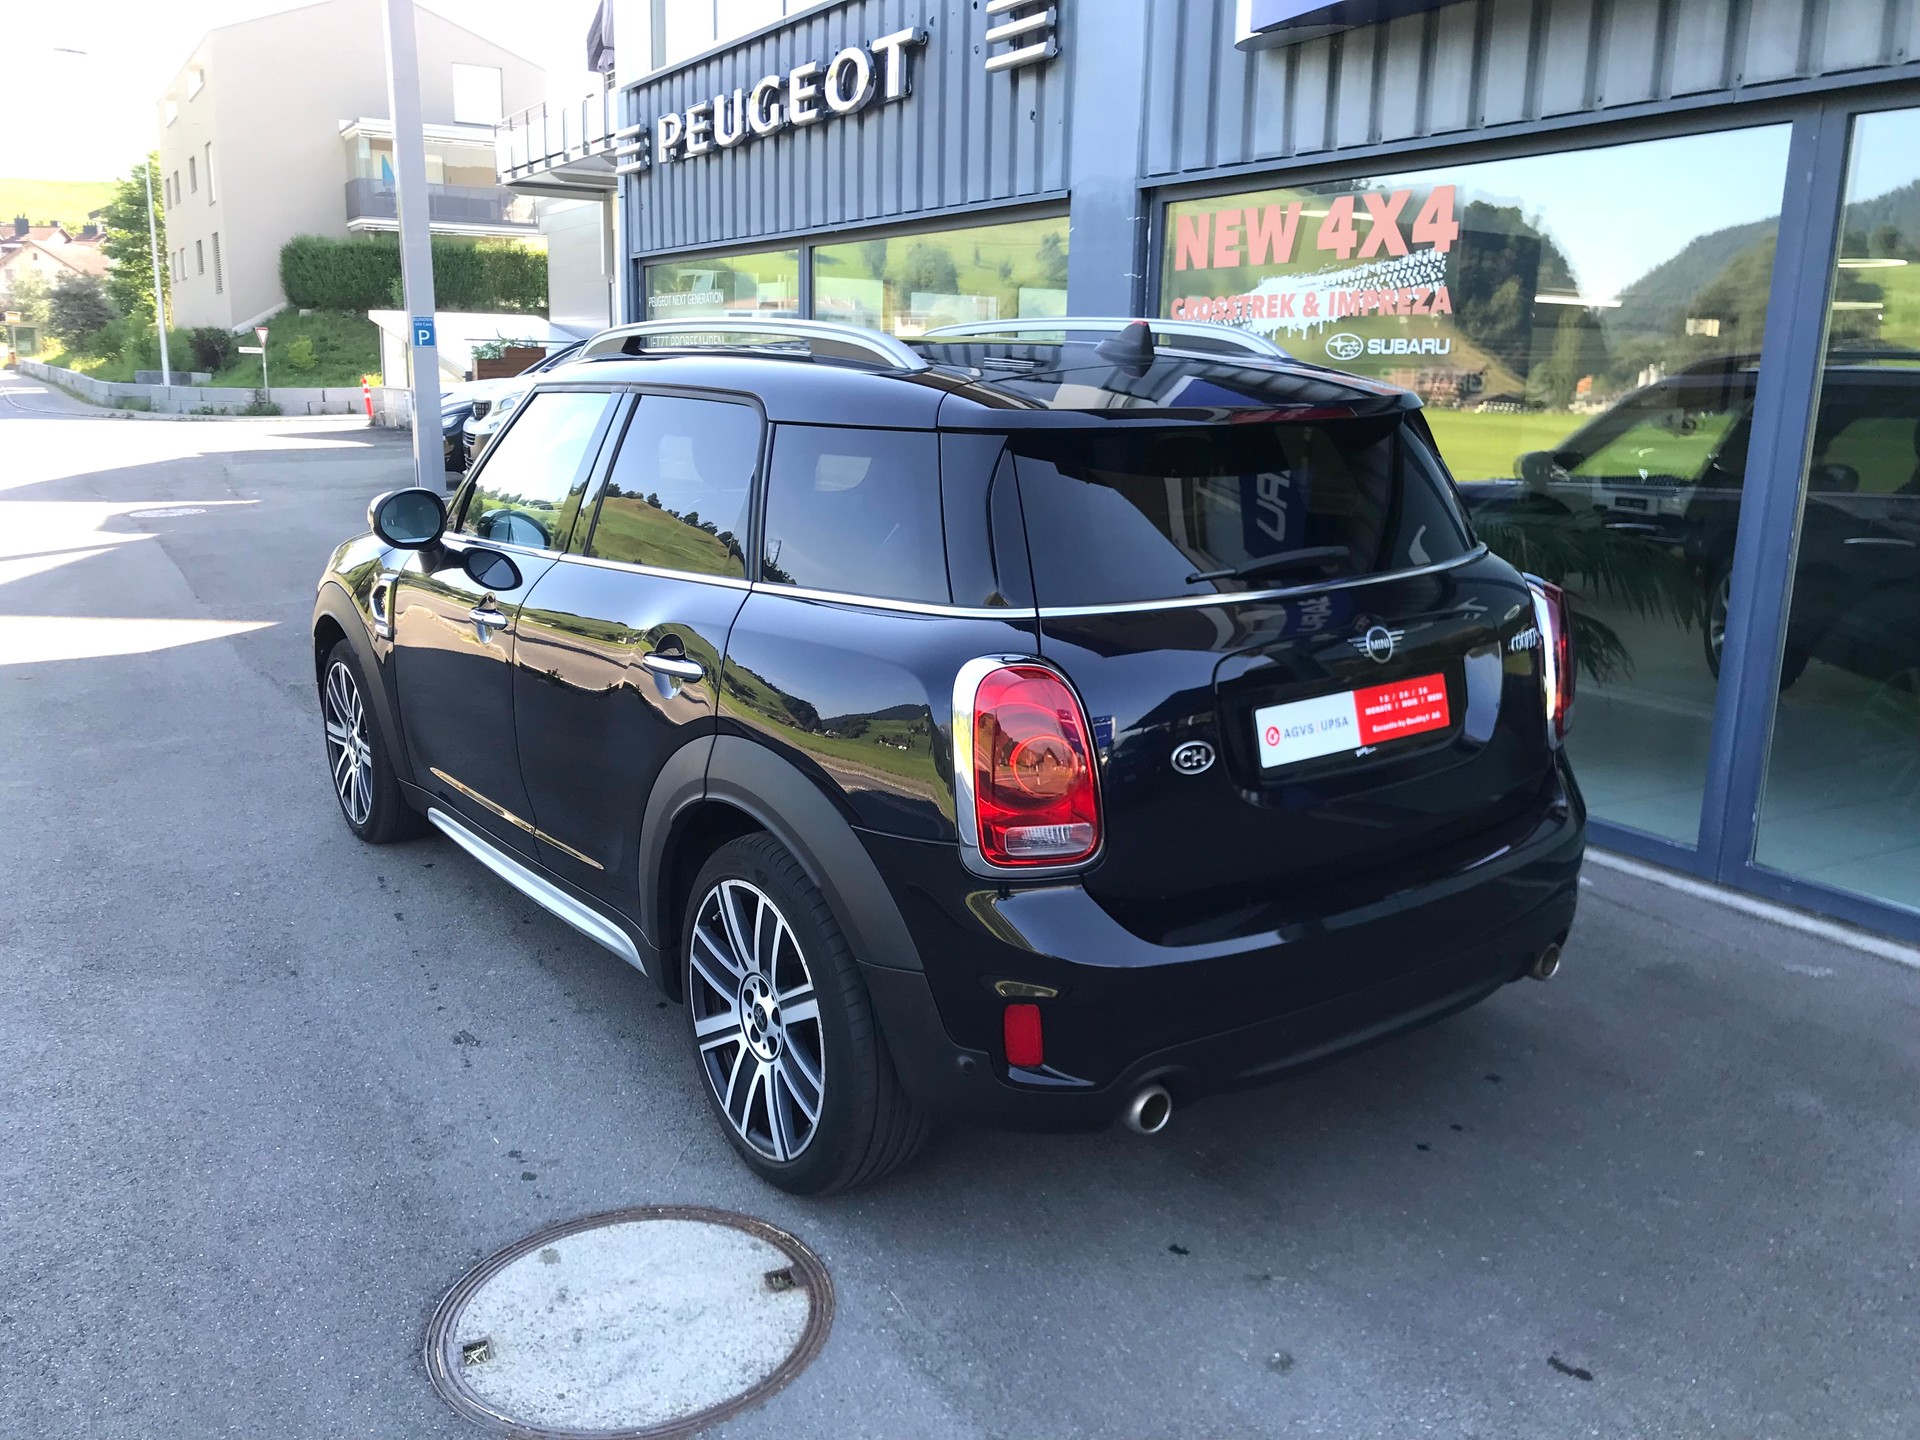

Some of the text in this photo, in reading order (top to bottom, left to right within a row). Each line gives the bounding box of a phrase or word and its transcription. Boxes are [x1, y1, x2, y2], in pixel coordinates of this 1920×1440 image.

[658, 26, 921, 163] PEUGEOT
[1175, 185, 1459, 271] NEW 4X4
[648, 292, 723, 307] PEUGEOT NEXT GENERATION
[1170, 287, 1452, 321] CROSSTREK & IMPREZA
[419, 330, 430, 345] P
[1367, 338, 1450, 355] SUBARU
[1370, 638, 1390, 651] MINI
[1283, 716, 1349, 739] AGVS UPSA
[1179, 747, 1207, 768] CH
